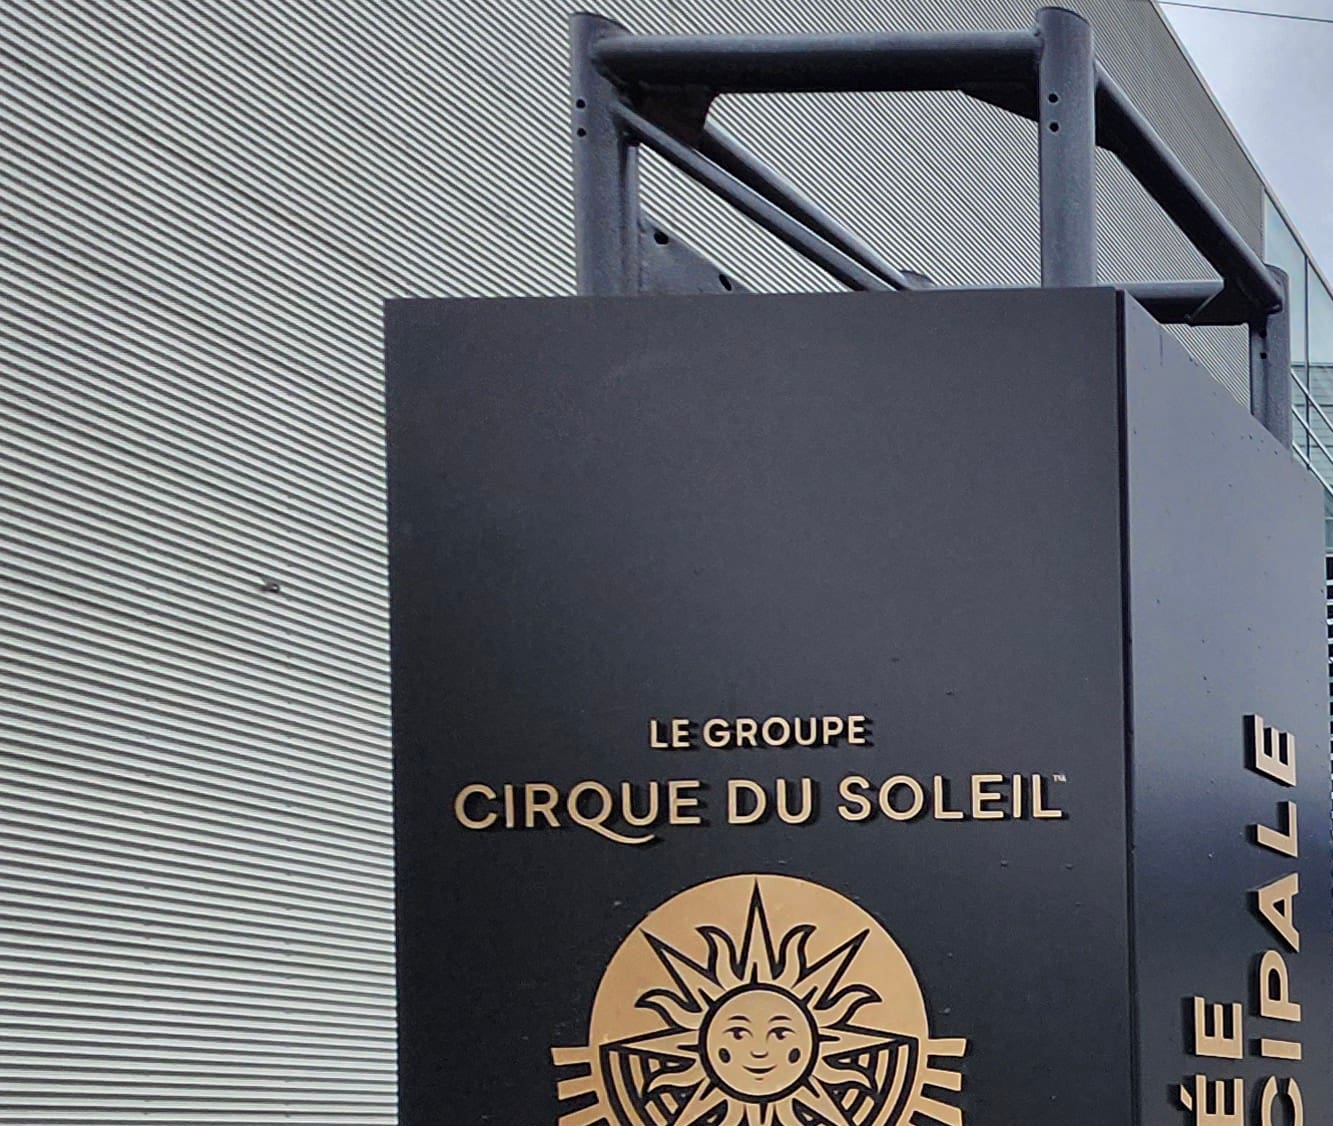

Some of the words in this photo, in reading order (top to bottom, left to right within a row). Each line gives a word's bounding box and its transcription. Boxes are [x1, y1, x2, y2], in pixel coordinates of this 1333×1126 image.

[650, 719, 690, 748] LE
[703, 715, 866, 748] GROUPE
[455, 780, 701, 844] CIRQUE
[727, 778, 813, 824] DU
